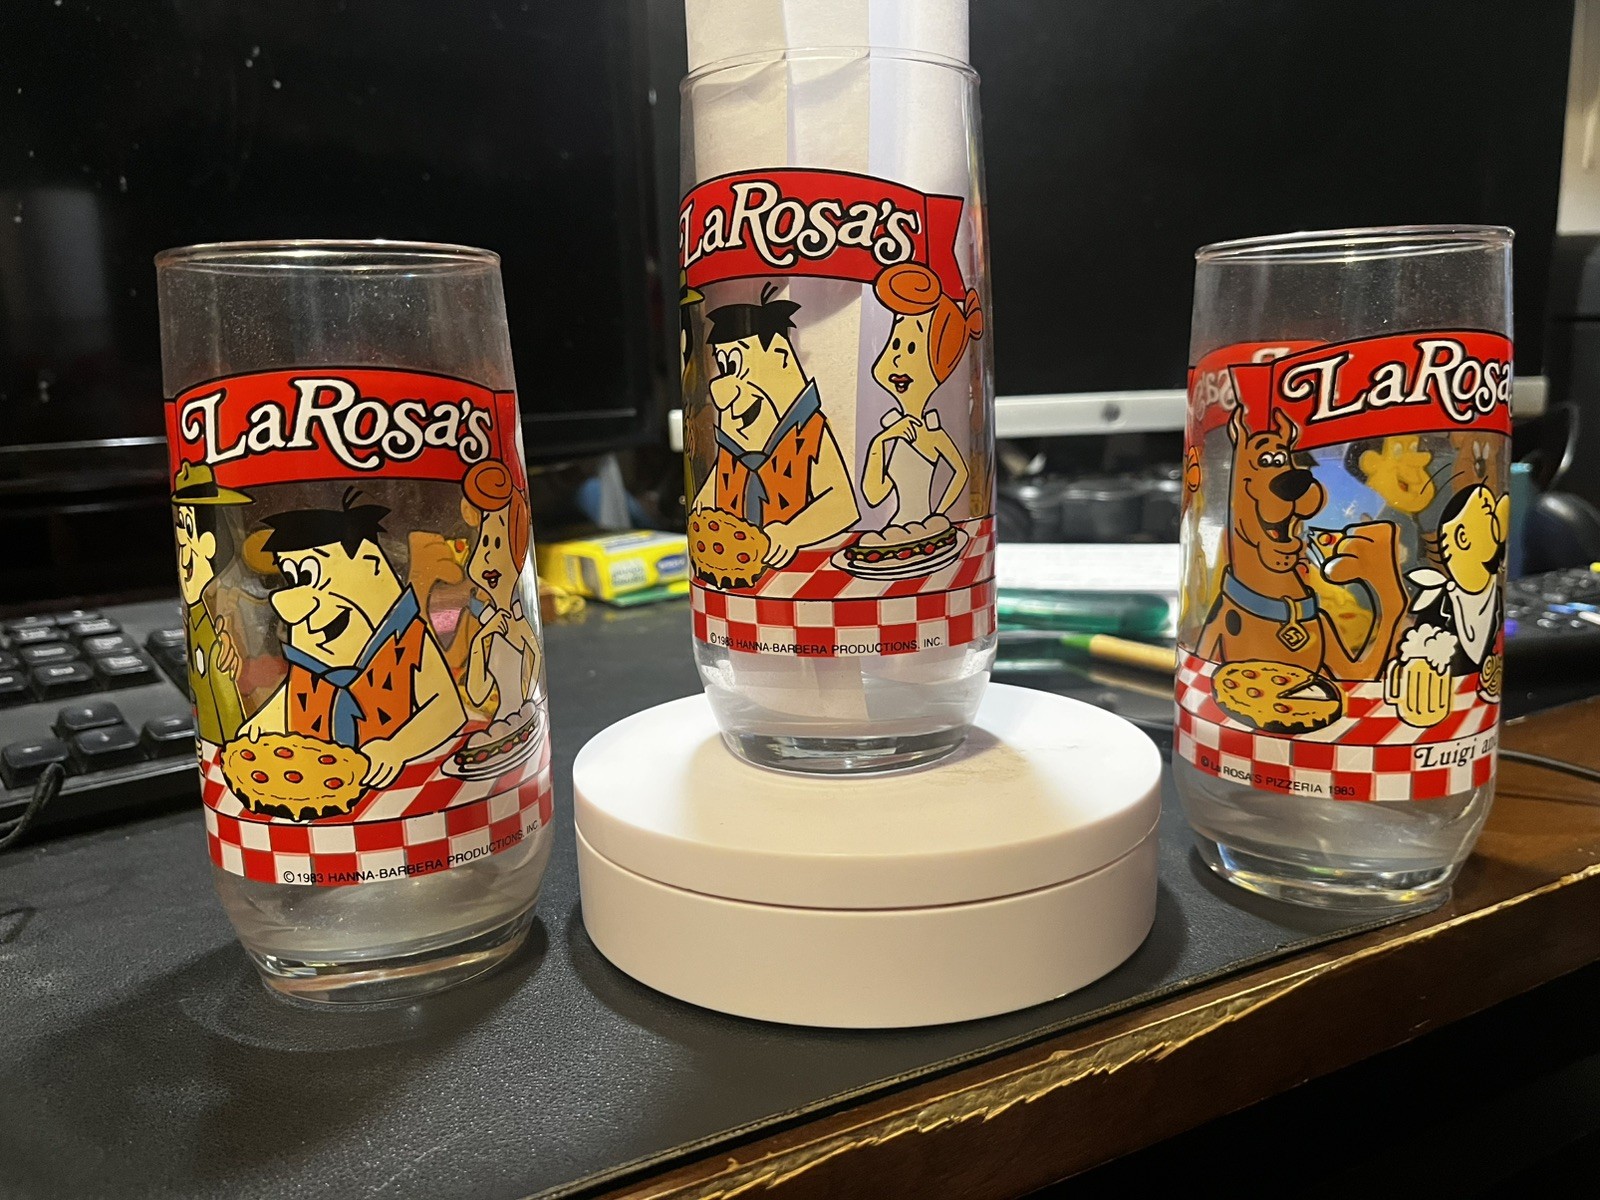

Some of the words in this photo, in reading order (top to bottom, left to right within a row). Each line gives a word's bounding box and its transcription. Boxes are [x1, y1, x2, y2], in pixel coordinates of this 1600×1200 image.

[679, 181, 922, 266] LaRosa's
[181, 378, 491, 468] LaRosa's
[736, 639, 827, 654] HANNA-BARBERA
[1413, 737, 1477, 768] Luigi
[1265, 776, 1323, 793] PIZZERIA
[1328, 785, 1356, 796] 1983
[328, 859, 444, 883] HANNA-BARBERA
